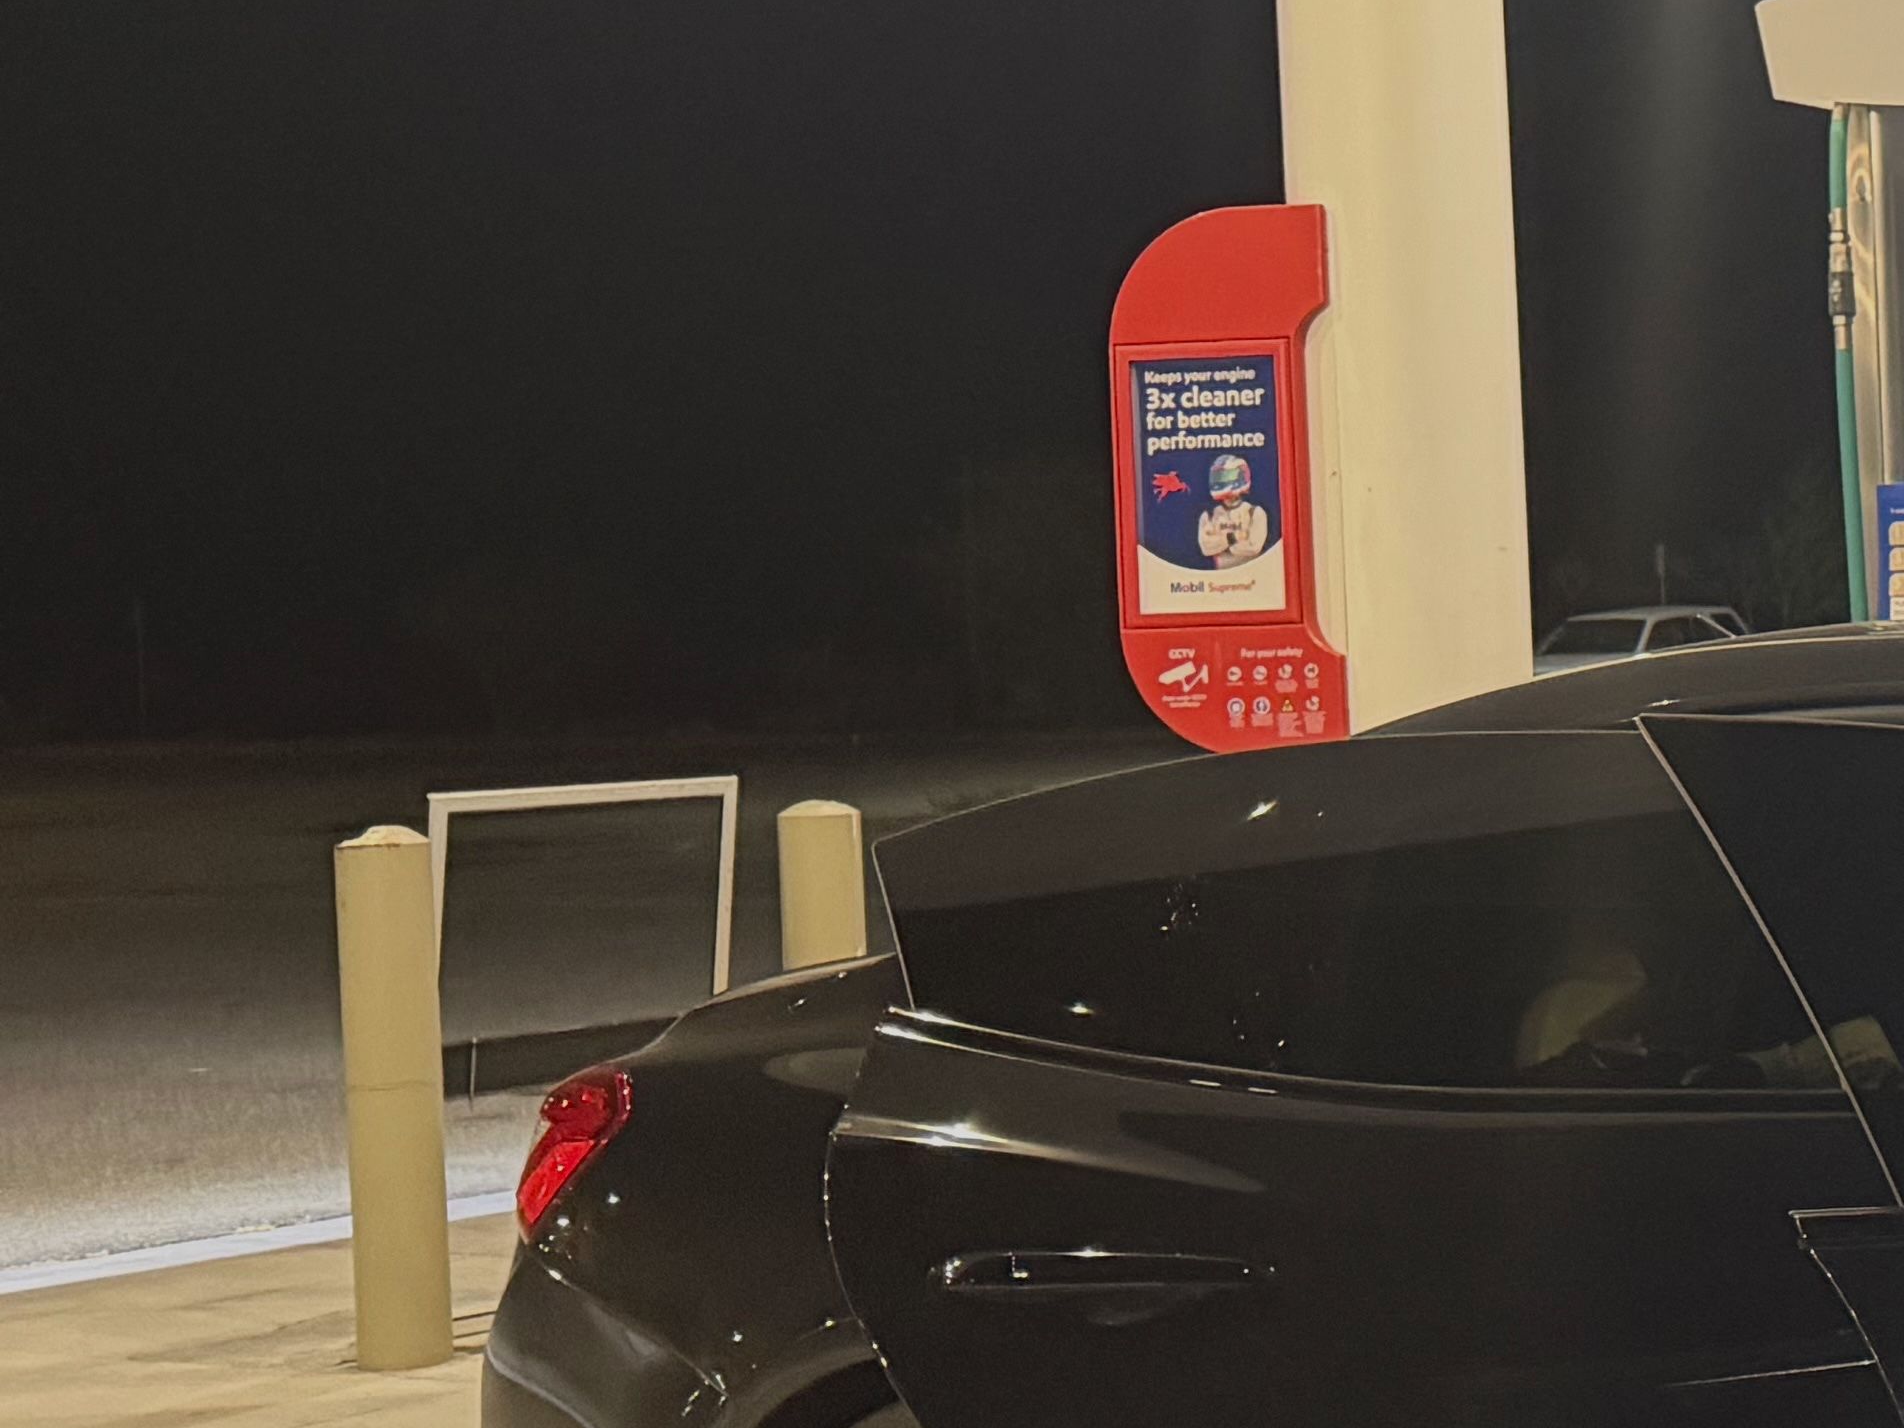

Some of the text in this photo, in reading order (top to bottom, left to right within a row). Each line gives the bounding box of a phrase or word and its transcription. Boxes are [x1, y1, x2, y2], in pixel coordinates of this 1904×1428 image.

[1144, 366, 1256, 387] Keeps your engine
[1146, 385, 1265, 410] 3x cleaner
[1146, 410, 1236, 431] for better
[1147, 430, 1265, 456] performance
[1170, 581, 1205, 593] Mobil
[1168, 648, 1196, 659] CCTV
